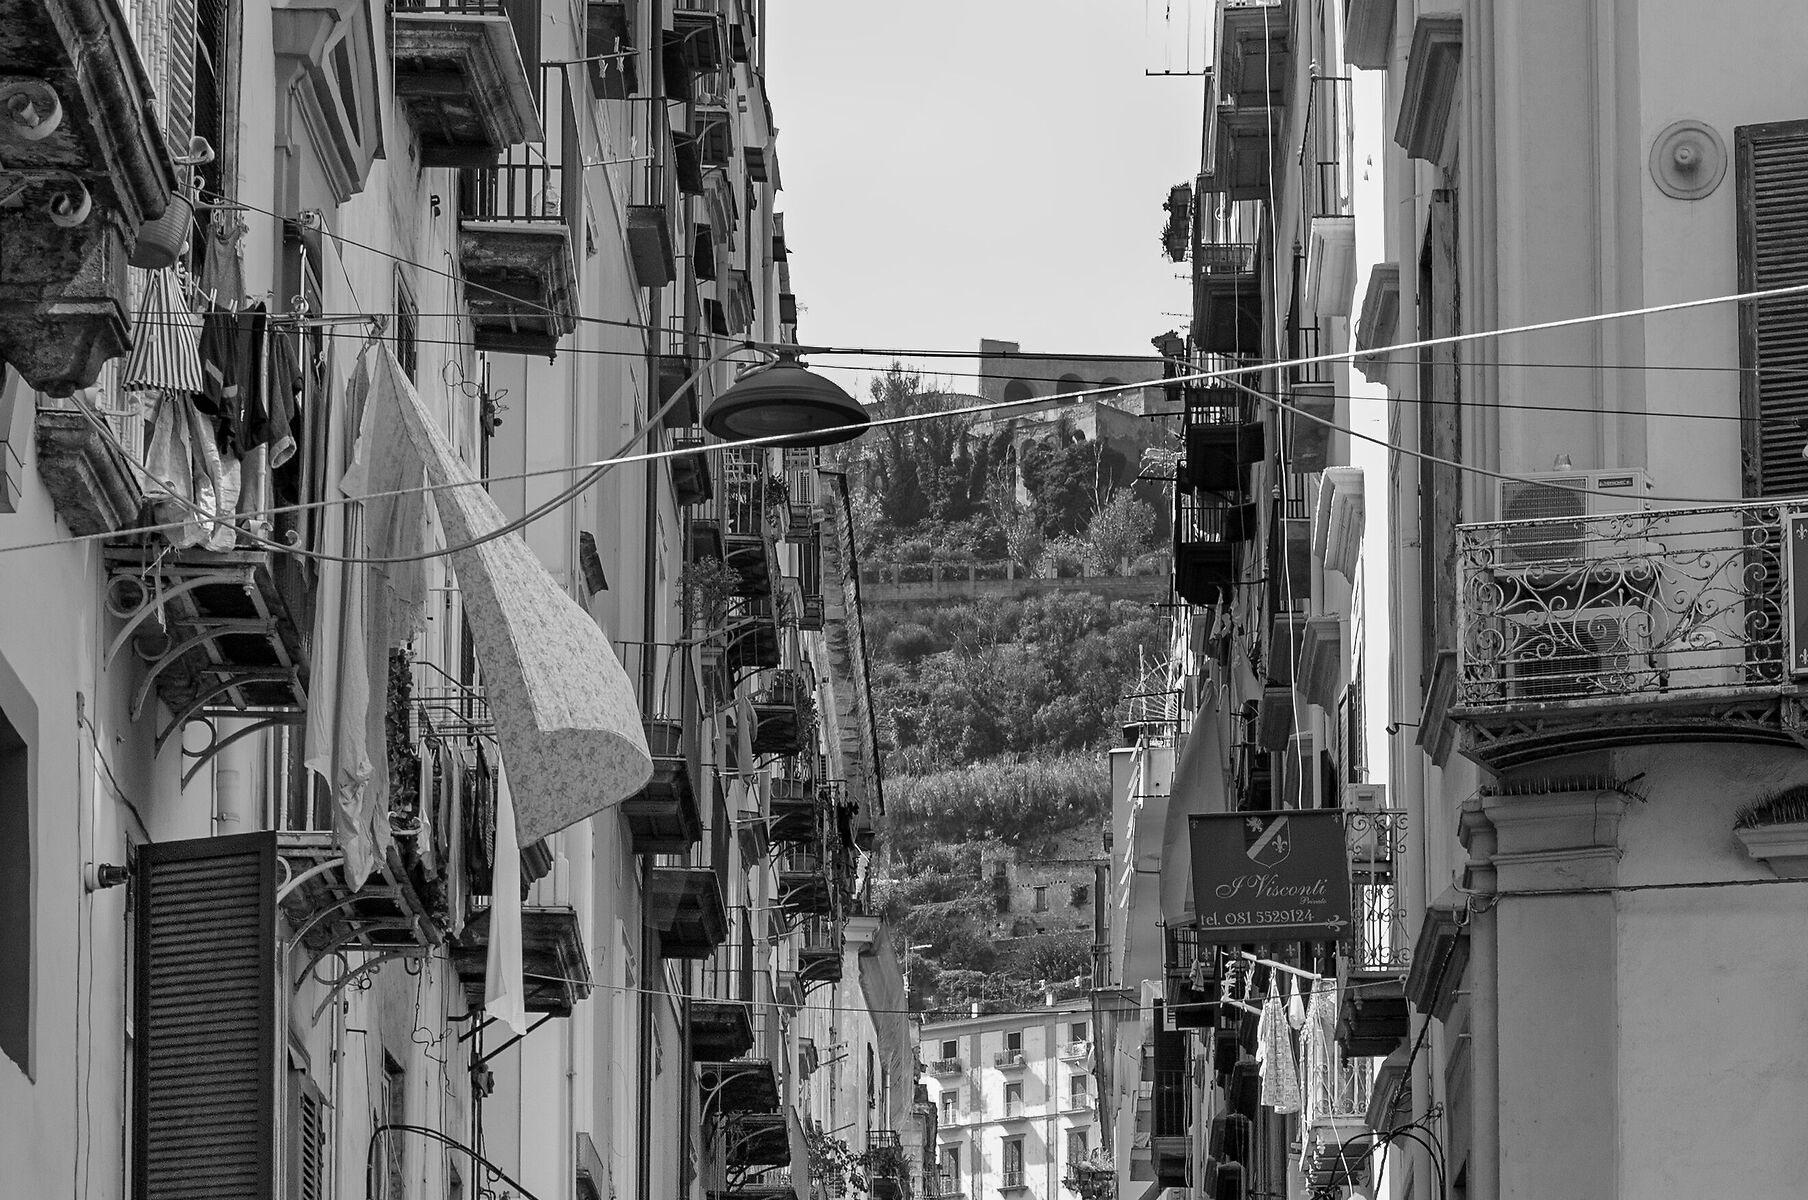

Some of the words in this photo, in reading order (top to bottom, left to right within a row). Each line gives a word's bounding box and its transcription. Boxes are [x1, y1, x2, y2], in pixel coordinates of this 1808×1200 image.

[1247, 873, 1328, 898] Visconti
[1201, 912, 1220, 926] tel.
[1225, 910, 1251, 925] 081
[1256, 909, 1315, 924] 5529124
